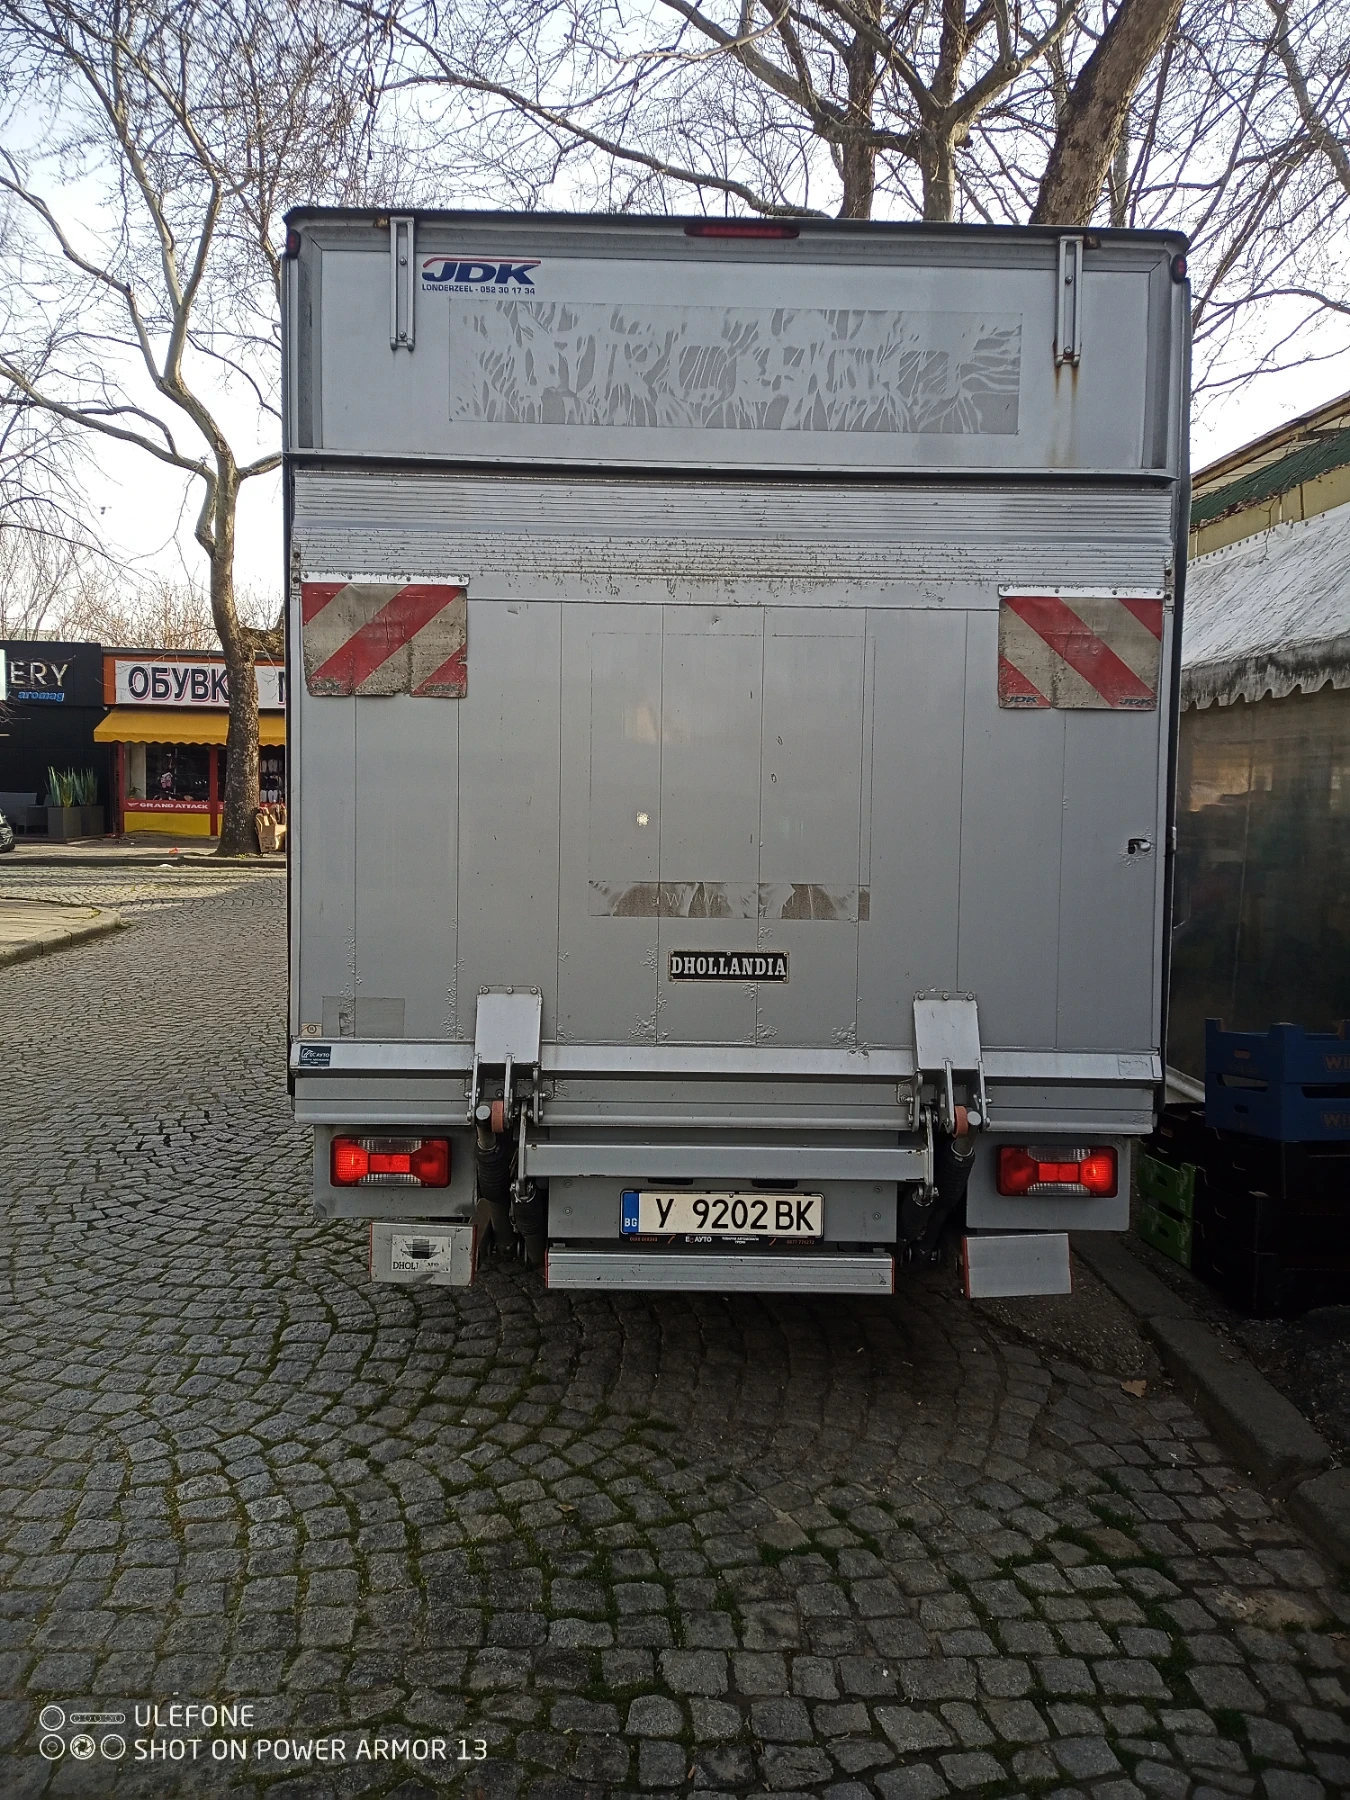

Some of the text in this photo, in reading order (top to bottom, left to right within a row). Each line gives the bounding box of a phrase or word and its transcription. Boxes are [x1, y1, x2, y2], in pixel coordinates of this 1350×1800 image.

[422, 261, 540, 285] JDK
[421, 284, 474, 293] LONDERZEEL
[480, 286, 496, 294] 052
[498, 286, 509, 294] 30
[525, 287, 536, 295] 34
[10, 661, 69, 687] ERY
[175, 802, 209, 810] ATTACK
[670, 956, 787, 976] DHOLLANDIA
[624, 1218, 638, 1227] BG
